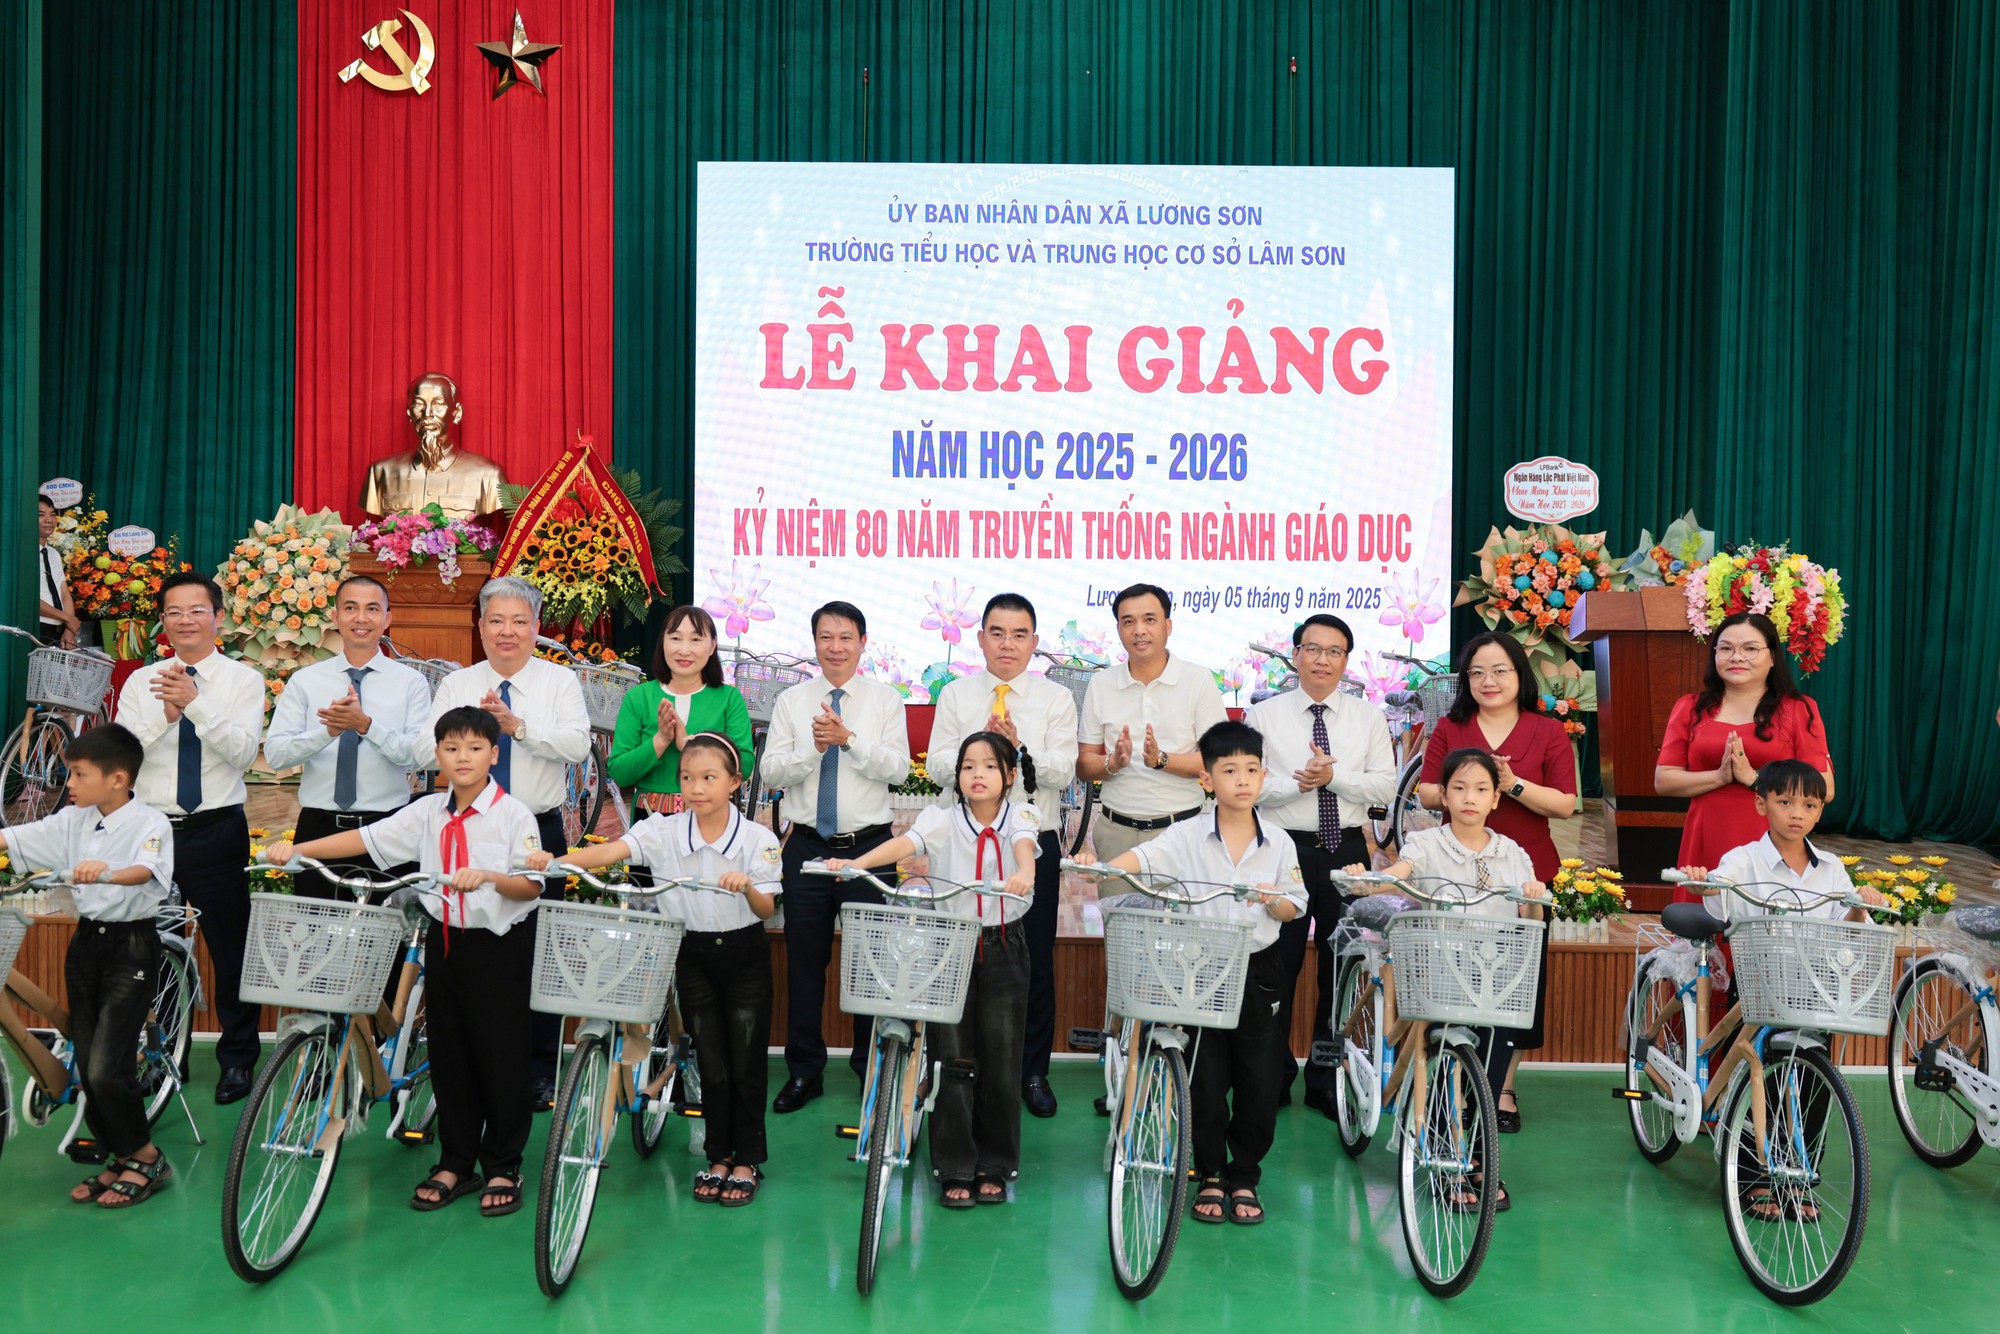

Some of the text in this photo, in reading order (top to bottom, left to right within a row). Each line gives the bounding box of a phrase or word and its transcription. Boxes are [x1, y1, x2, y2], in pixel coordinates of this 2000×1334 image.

[889, 195, 1262, 226] ỦY BAN NHÂN DÂN XÃ LƯƠNG SƠN
[805, 231, 1345, 271] TRƯỜNG TIỂU HỌC VÀ TRUNG HỌC CƠ SỞ LÂM SƠN
[759, 286, 1389, 395] LỄ KHAI GIẢNG
[892, 419, 1248, 491] NĂM HỌC 2025 - 2026
[1511, 485, 1528, 496] Chúc
[1551, 485, 1569, 496] Khai
[1570, 485, 1592, 498] Giảng
[1513, 472, 1590, 484] Ngân Hàng Lộc Phát Việt Nam
[601, 480, 626, 514] CHÚC
[1537, 499, 1550, 511] Học
[1551, 500, 1567, 510] 2025
[1570, 500, 1586, 510] 2026
[733, 487, 1412, 574] KỶ NIỆM 80 NĂM TRUYỀN THỐNG NGÀNH GIÁO DỤC
[1086, 584, 1121, 607] Lươ
[1182, 585, 1221, 614] ngày
[1225, 586, 1242, 608] 05
[1247, 586, 1291, 615] tháng
[1295, 586, 1304, 609] 9
[1308, 586, 1341, 609] năm
[1345, 587, 1381, 609] 2025
